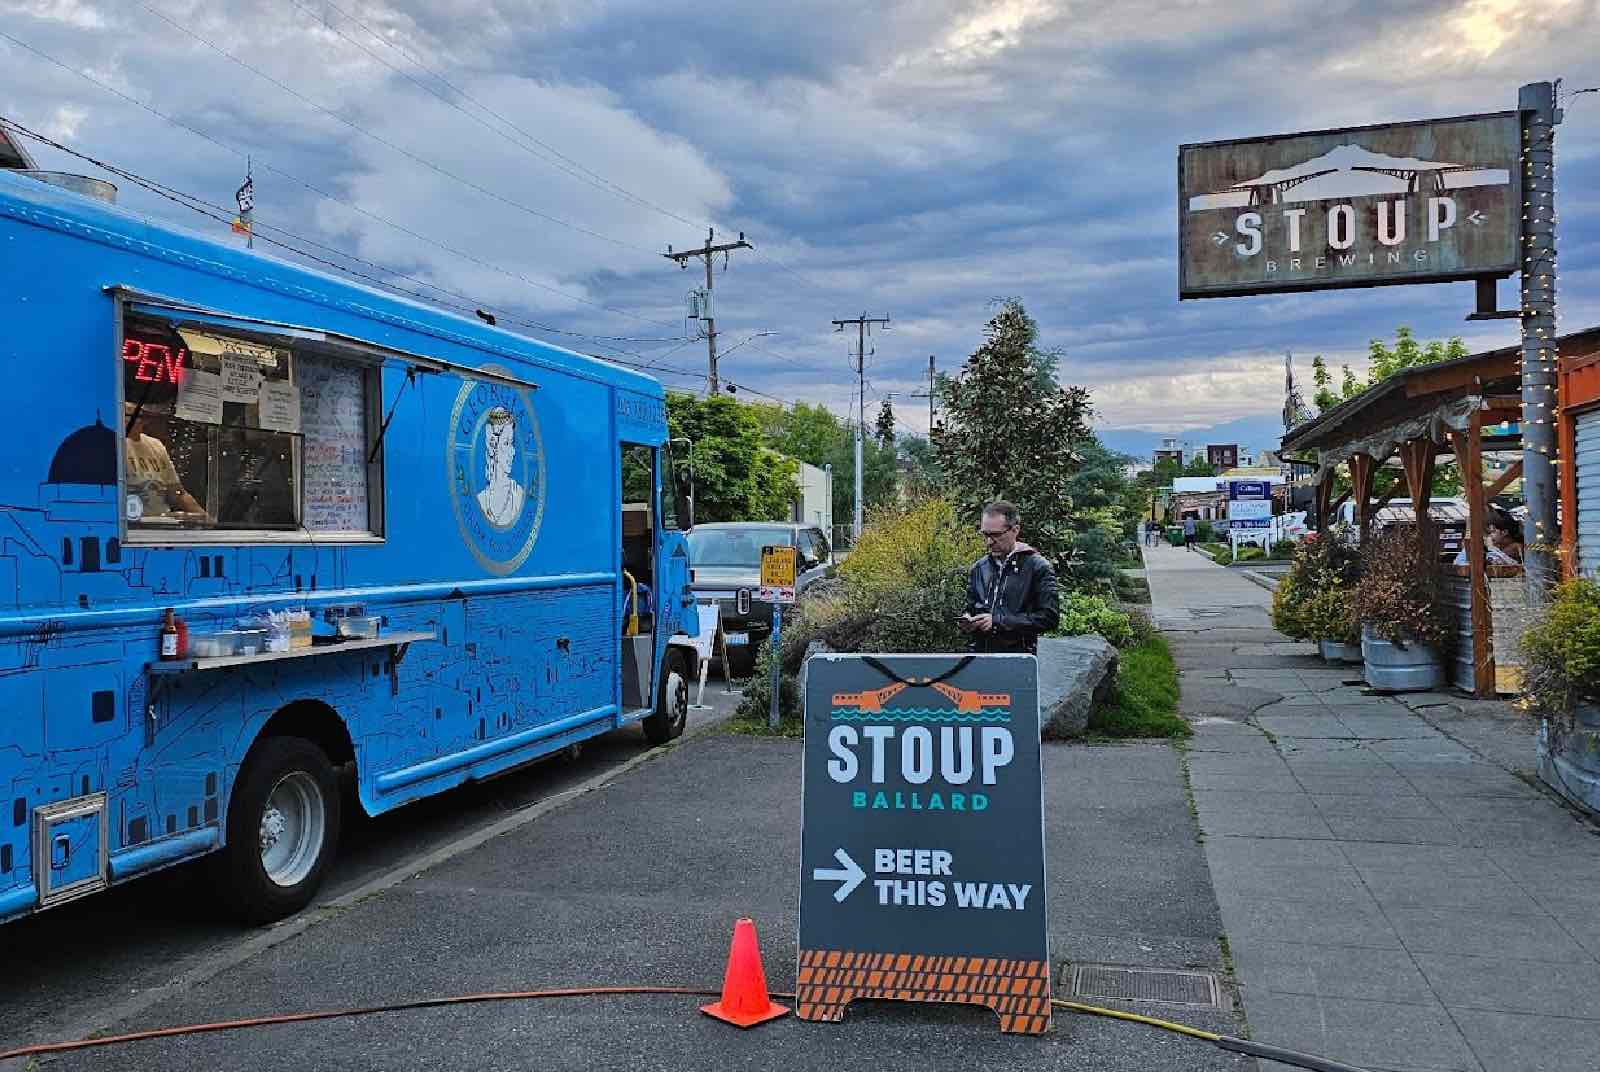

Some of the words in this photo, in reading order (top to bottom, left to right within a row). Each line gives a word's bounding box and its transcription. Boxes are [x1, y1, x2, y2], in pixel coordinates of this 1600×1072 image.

[1235, 196, 1457, 257] STOUP
[1265, 249, 1432, 273] BREWING
[122, 339, 186, 383] PEN
[827, 724, 1015, 785] STOUP
[852, 791, 991, 811] BALLARD
[874, 848, 953, 876] BEER
[873, 879, 947, 908] THIS
[952, 882, 1033, 911] WAY
